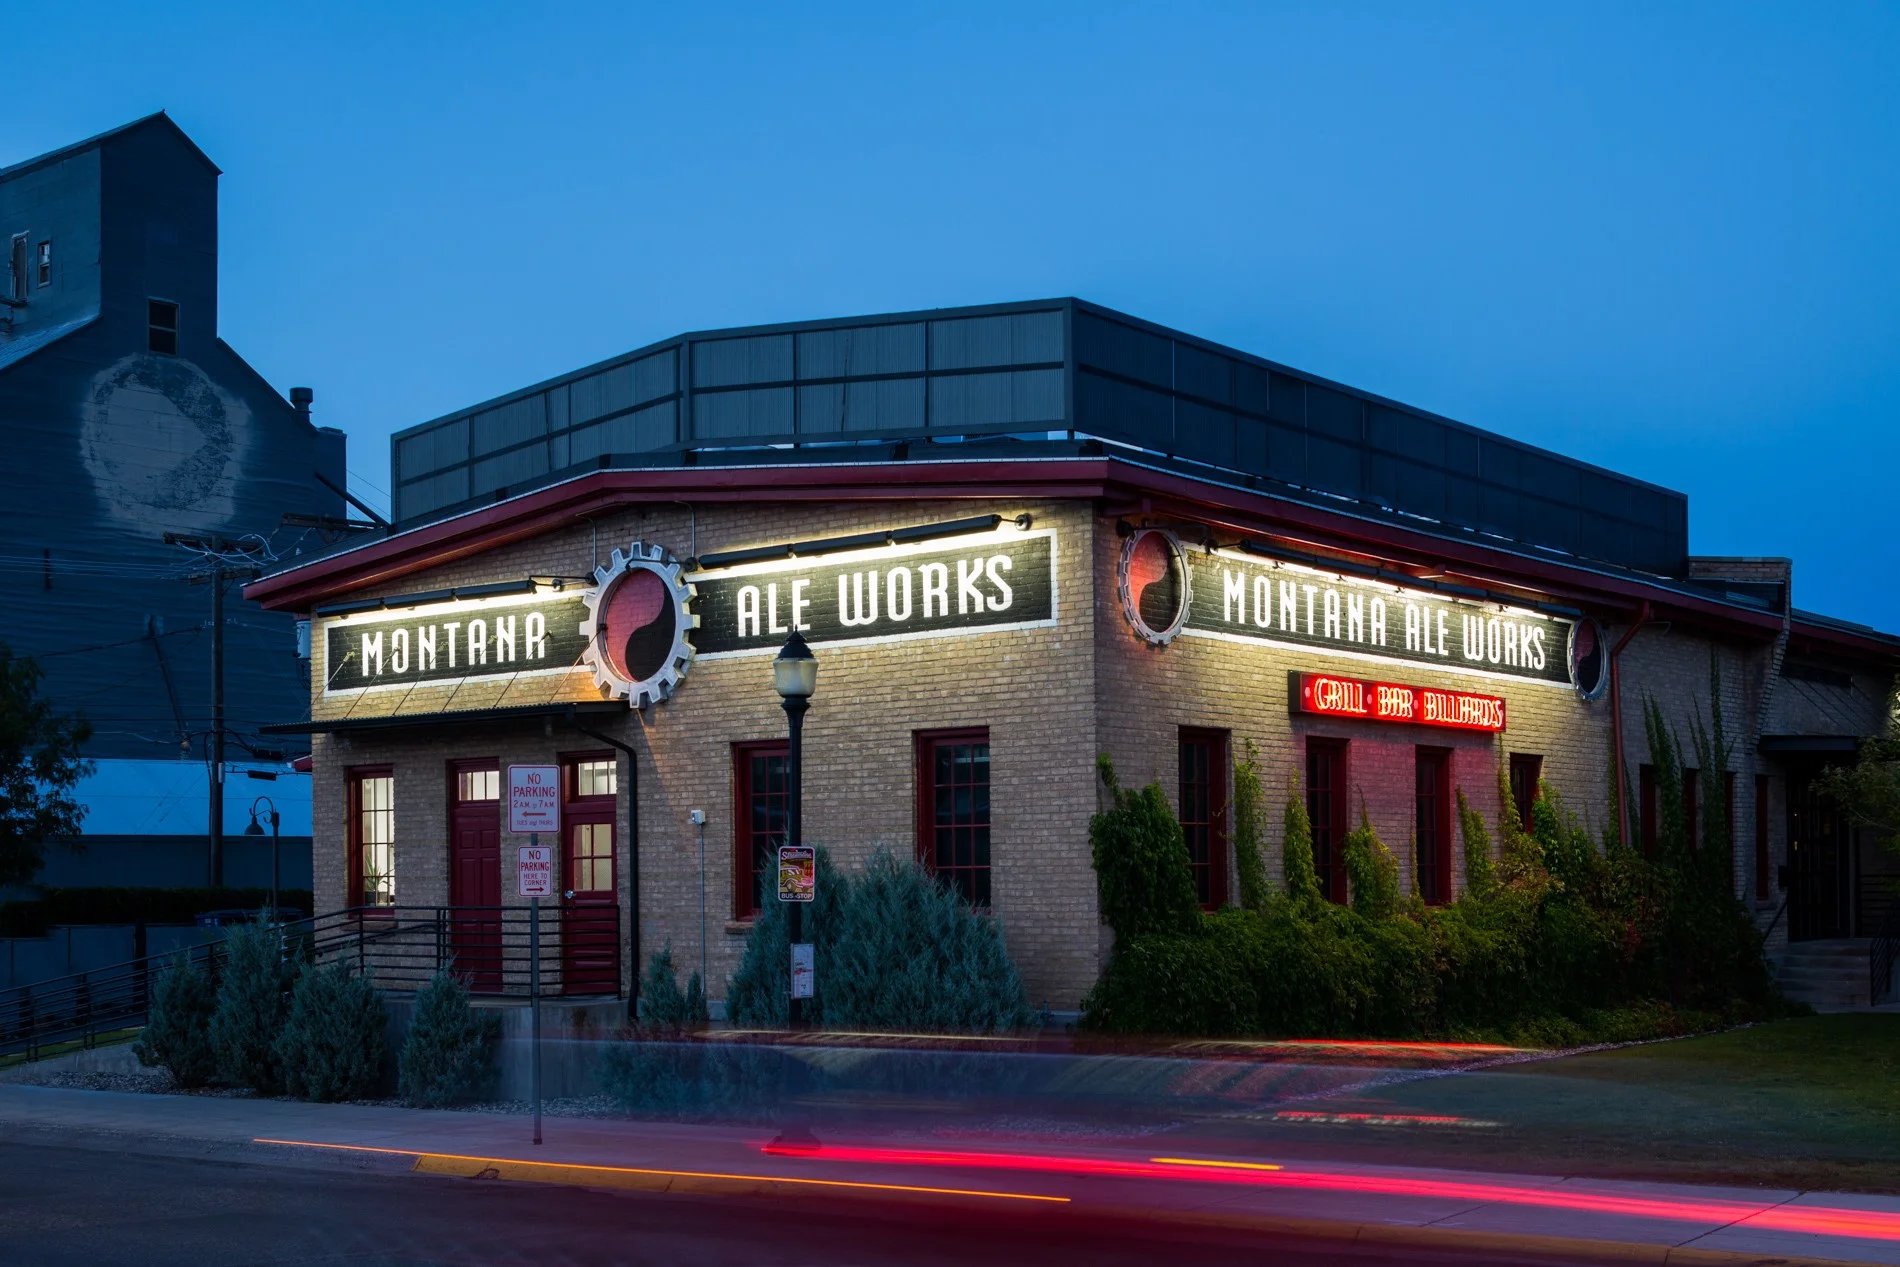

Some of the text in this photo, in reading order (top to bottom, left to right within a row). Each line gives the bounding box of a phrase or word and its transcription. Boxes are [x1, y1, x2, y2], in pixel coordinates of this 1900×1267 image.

[361, 554, 1014, 677] MONTANA ALE WORKS
[1223, 569, 1547, 671] MONTANA ALE WORKS
[1314, 678, 1504, 728] GRILL BAR BILLIARDS
[527, 773, 541, 785] NO
[513, 786, 556, 798] PARKING
[528, 850, 542, 860] NO
[520, 861, 550, 872] PARKING
